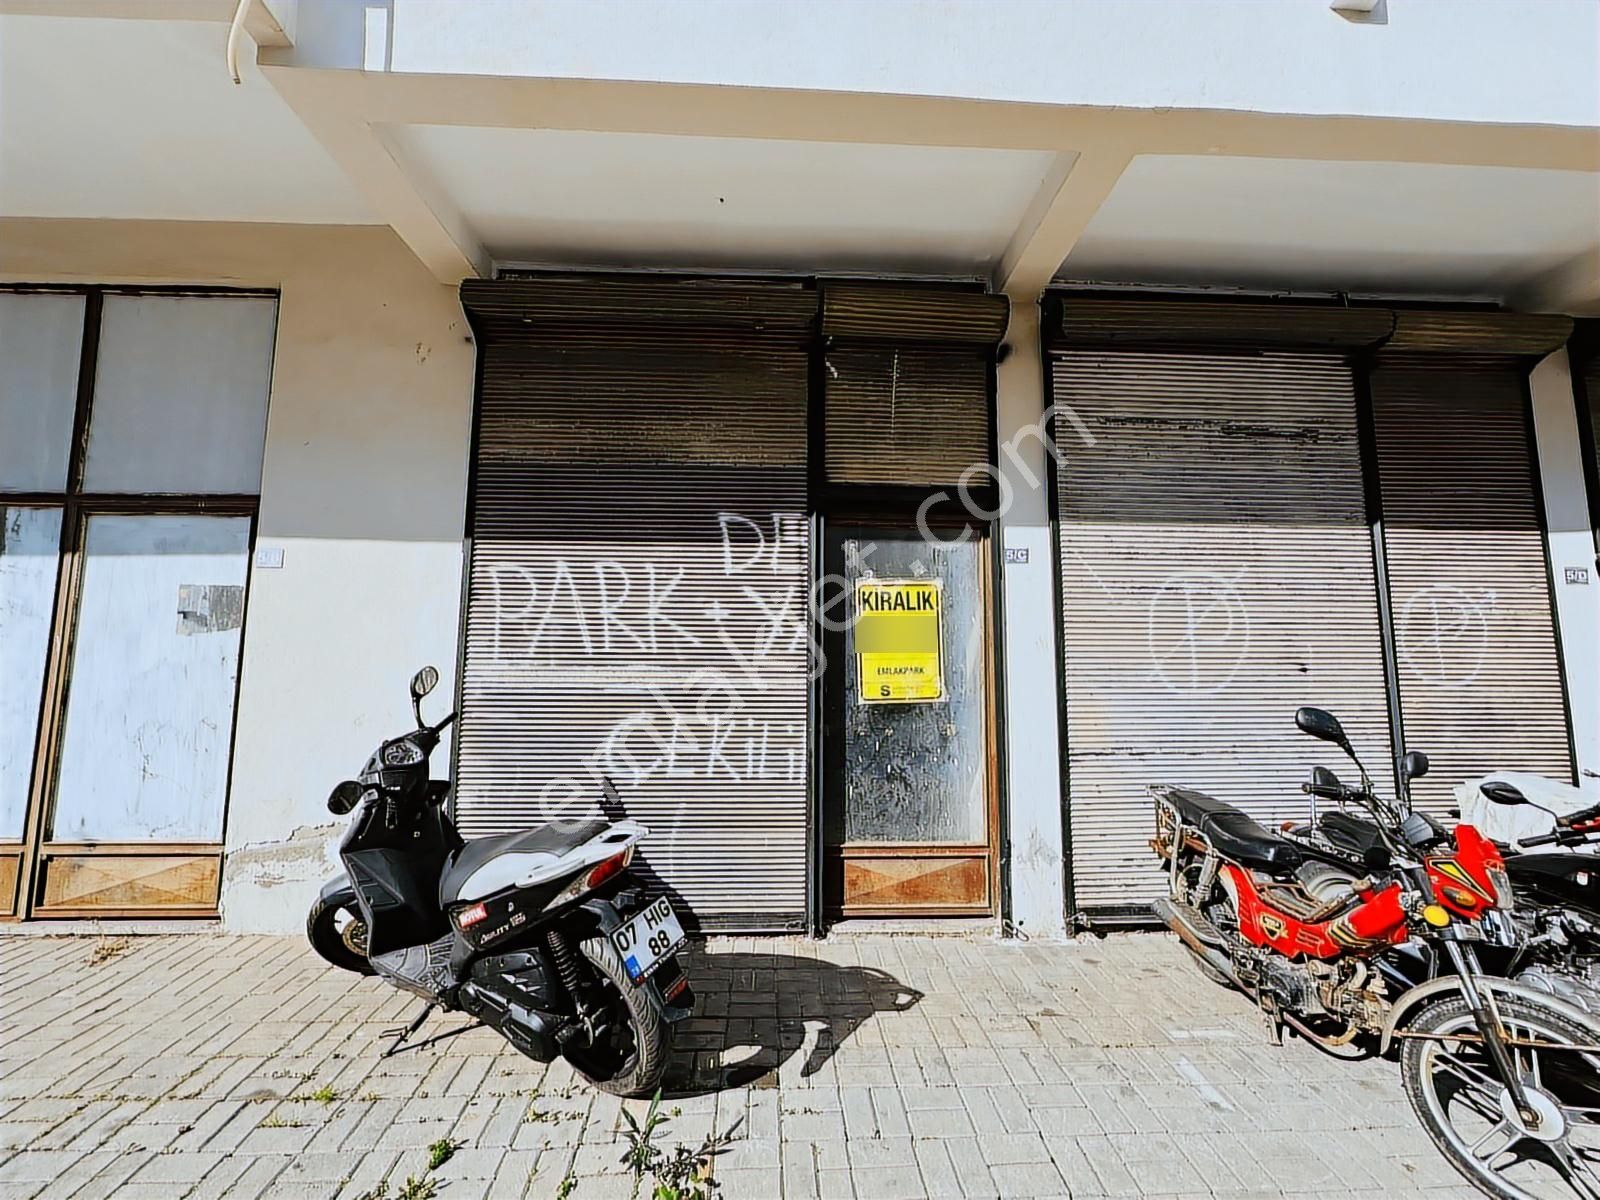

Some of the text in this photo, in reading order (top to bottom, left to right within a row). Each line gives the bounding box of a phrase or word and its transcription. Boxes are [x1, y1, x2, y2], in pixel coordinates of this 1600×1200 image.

[1566, 569, 1587, 582] 5/D
[487, 560, 699, 659] PARK
[862, 589, 935, 612] KİRALIK
[615, 900, 670, 951] 07 HIG
[648, 931, 670, 956] 88
